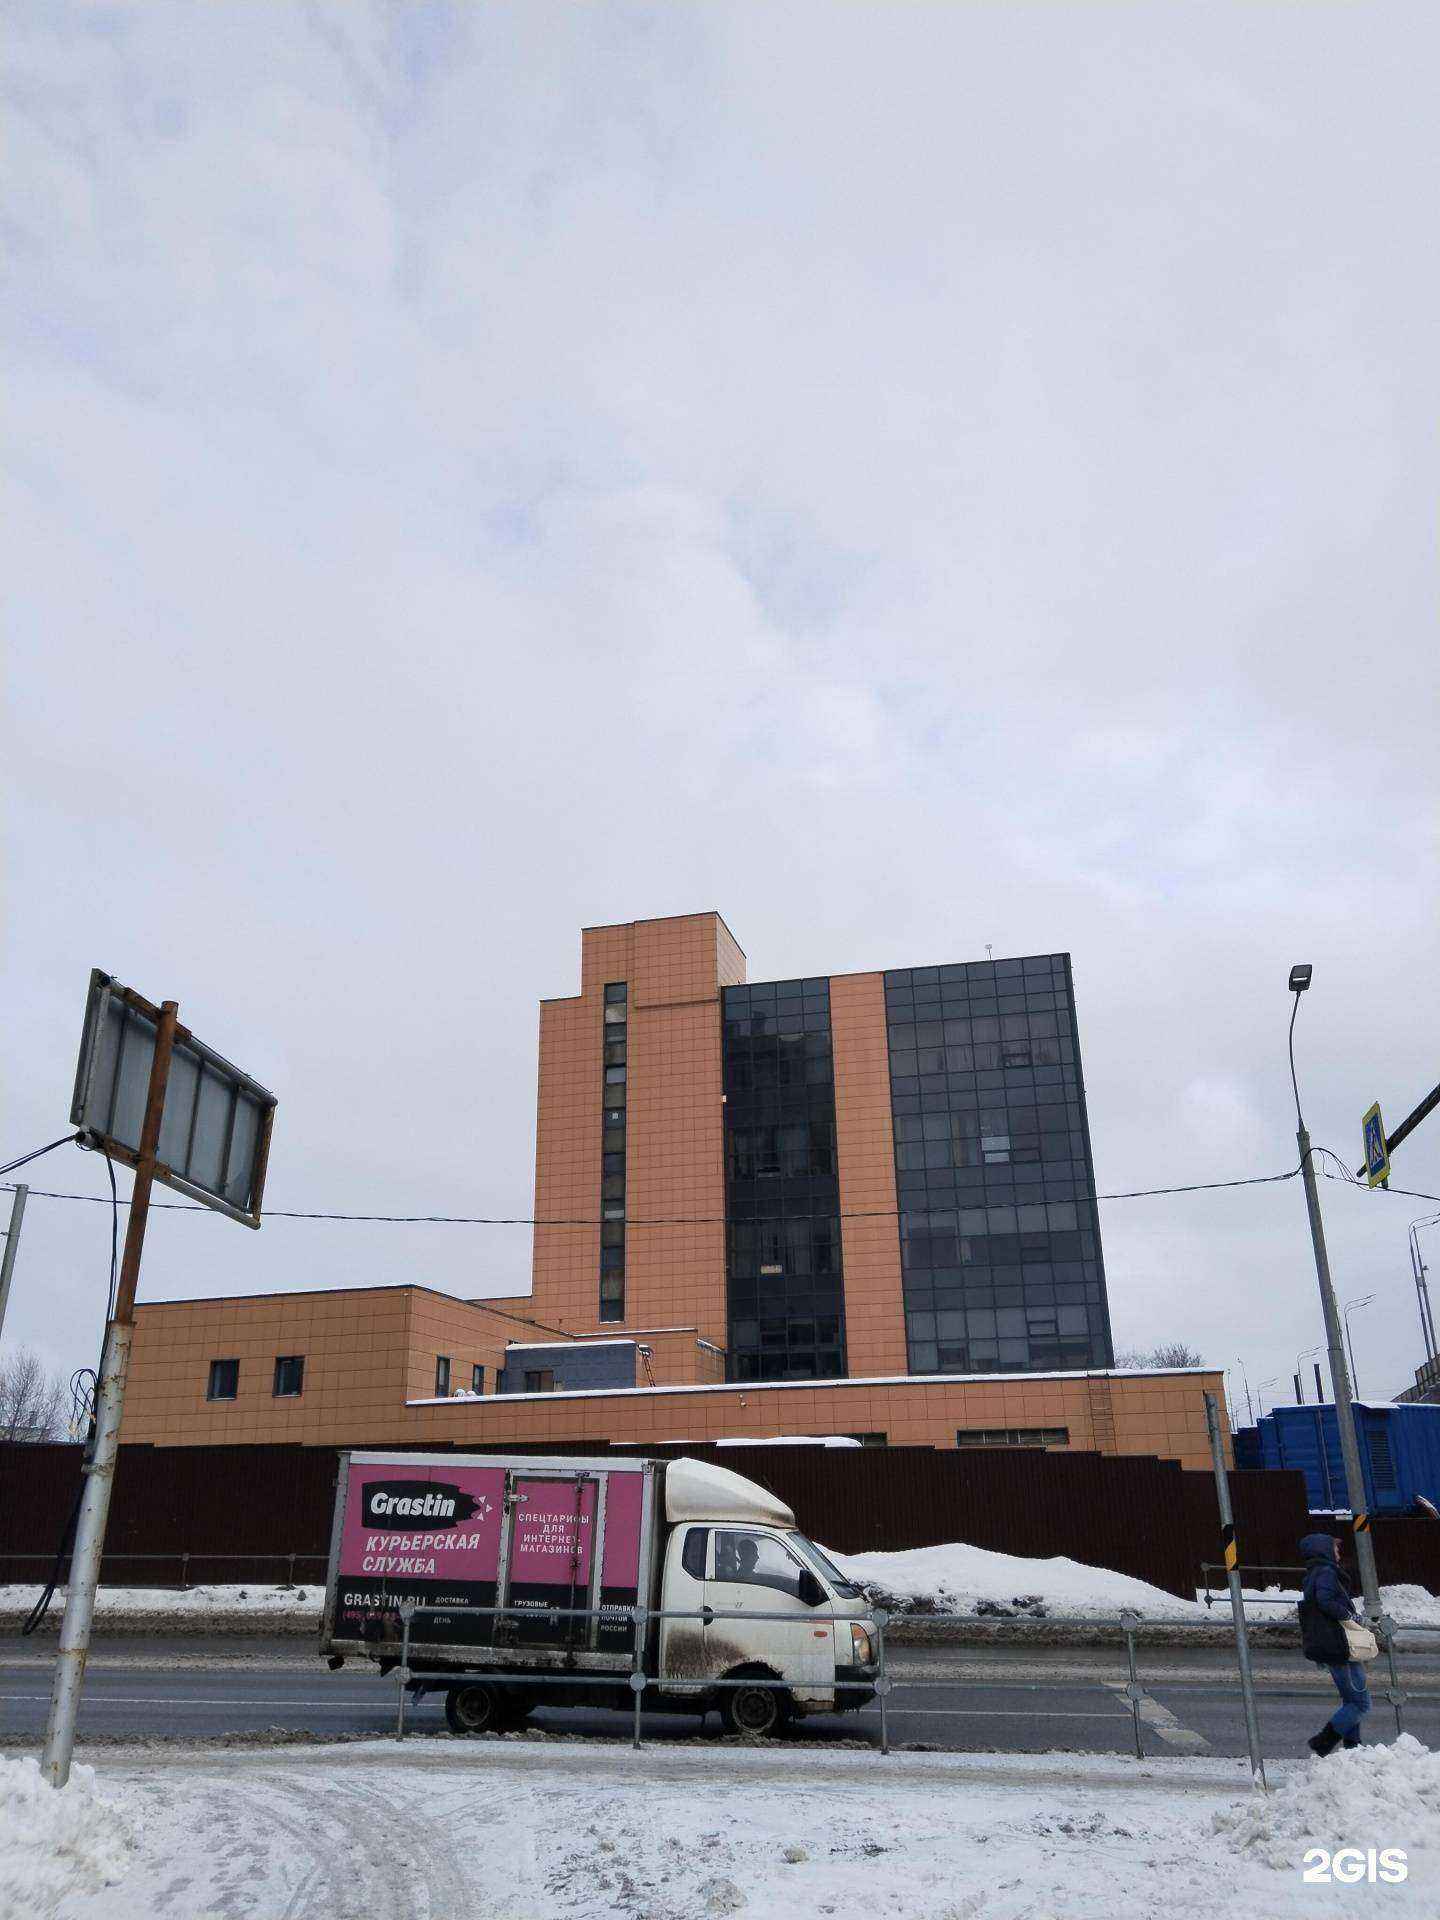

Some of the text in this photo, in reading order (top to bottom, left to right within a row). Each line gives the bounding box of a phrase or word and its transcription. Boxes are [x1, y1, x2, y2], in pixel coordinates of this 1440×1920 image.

[370, 1492, 456, 1517] Grastin
[543, 1524, 565, 1534] ДЛЯ
[365, 1533, 480, 1552] КУРЬЕРСКАЯ
[520, 1544, 583, 1555] МАГАЗИНОВ
[362, 1556, 436, 1574] СЛУЖБА
[344, 1593, 426, 1608] GRASTINRU
[434, 1596, 469, 1605] ДОСТАВКА
[514, 1600, 549, 1608] ГРУЗОВЫЕ
[600, 1624, 628, 1633] РОССИИ
